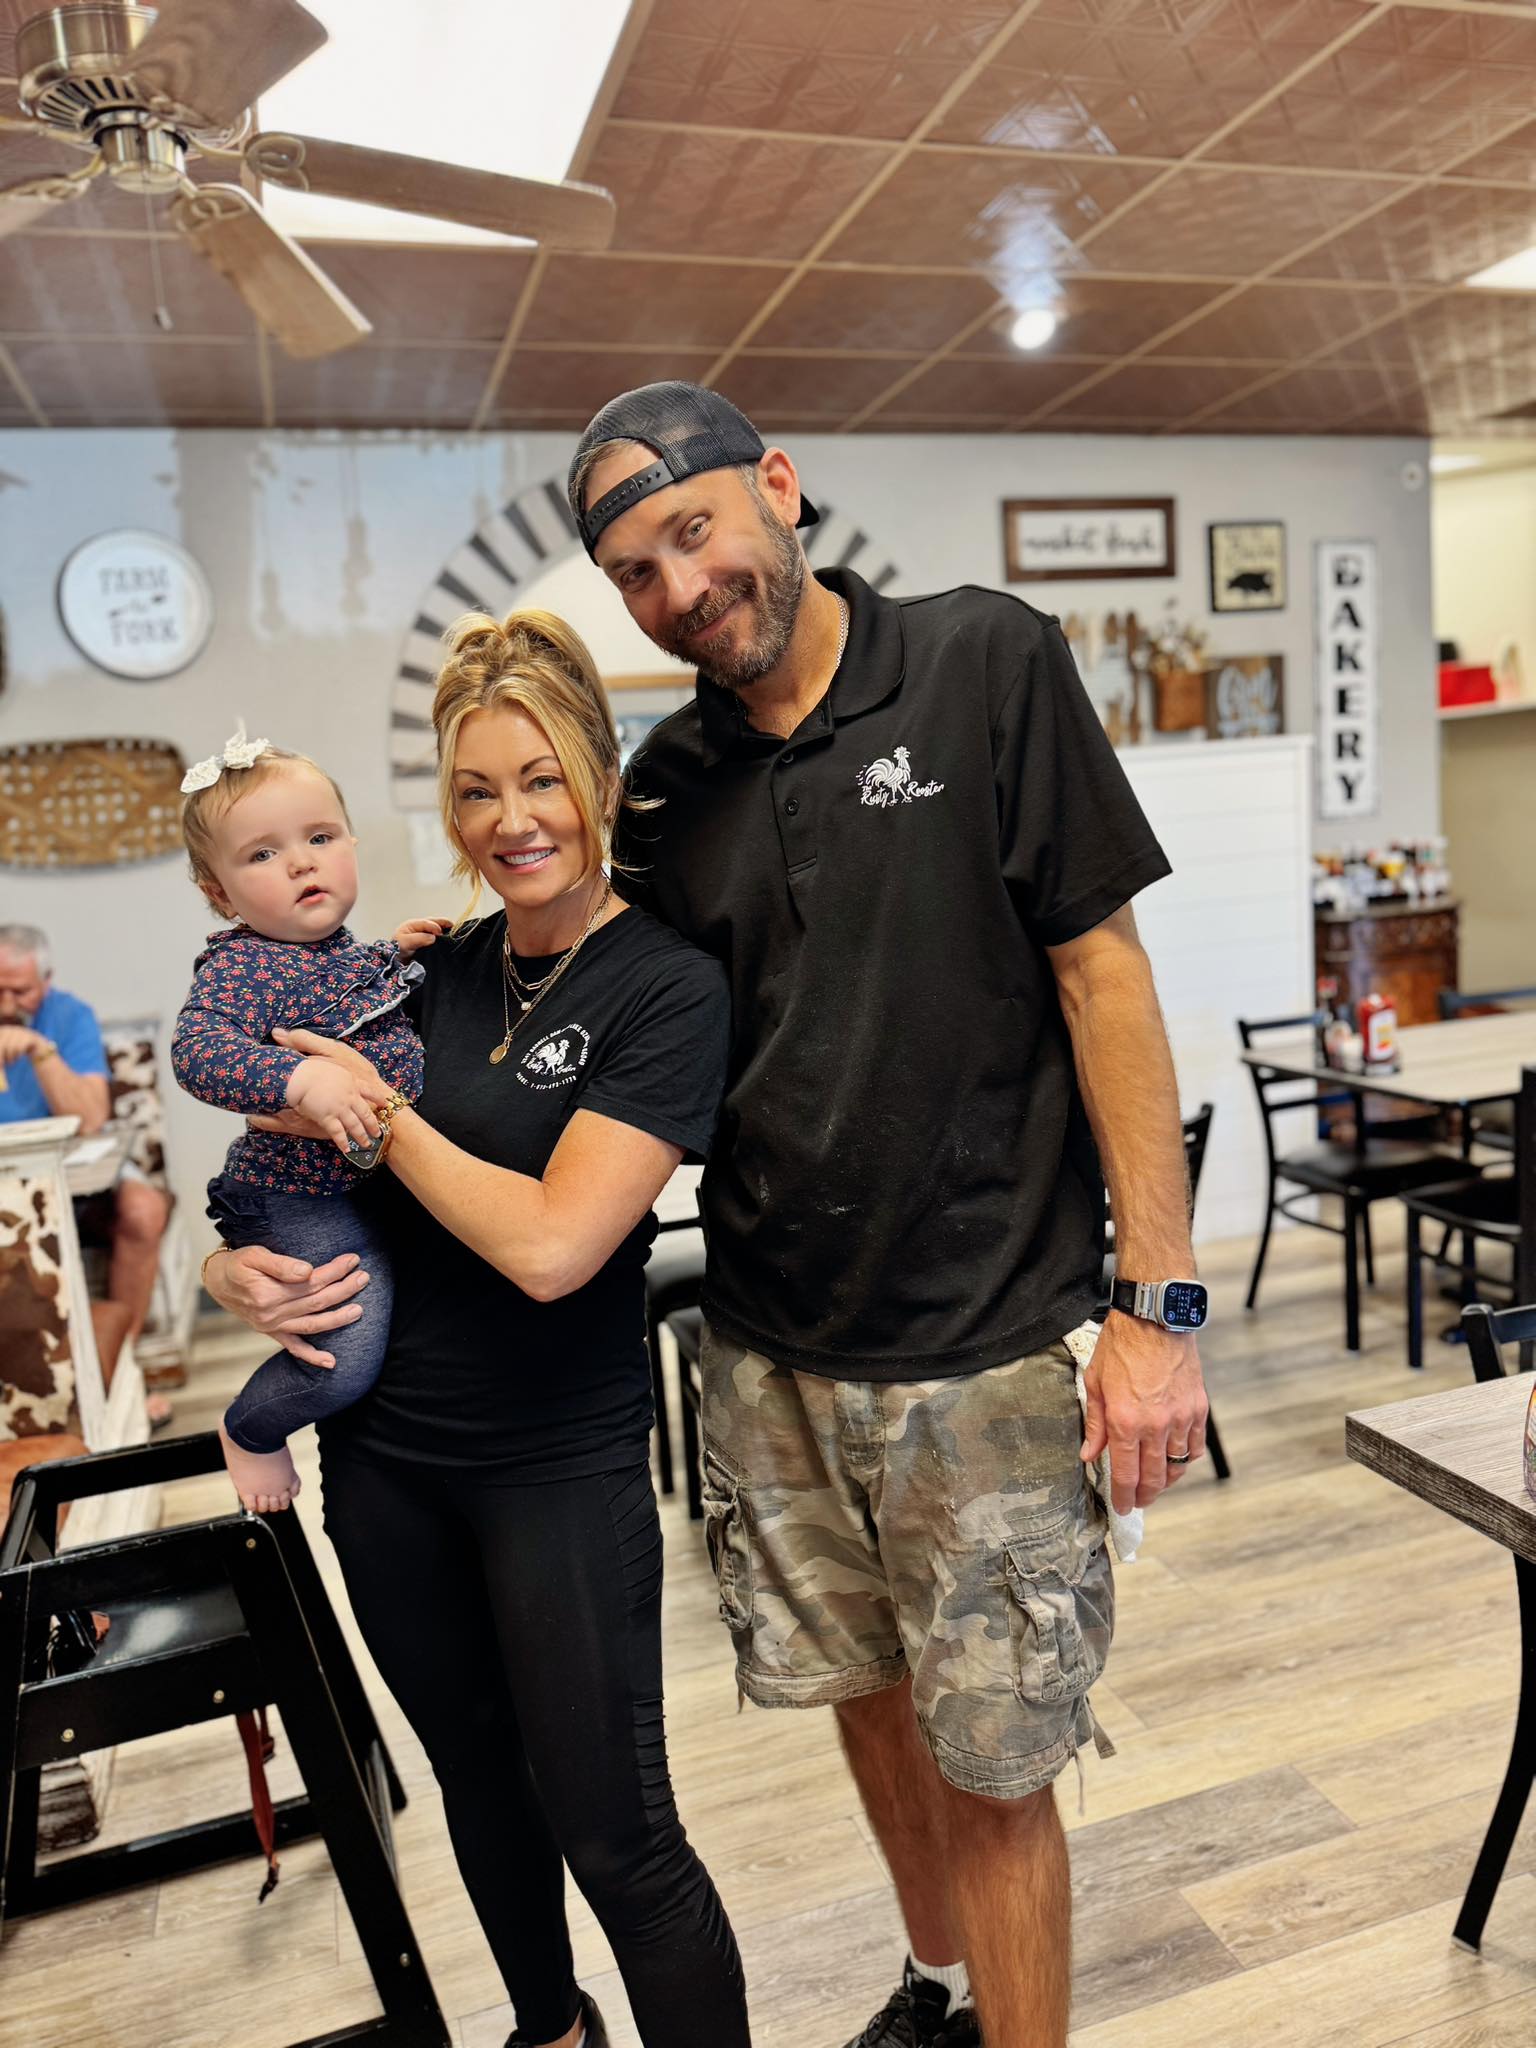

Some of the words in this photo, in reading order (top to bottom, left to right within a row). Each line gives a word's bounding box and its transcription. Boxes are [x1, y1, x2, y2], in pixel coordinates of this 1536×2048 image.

[1331, 554, 1361, 802] BAKERY
[860, 787, 890, 808] Rusty
[907, 780, 944, 797] Rooster
